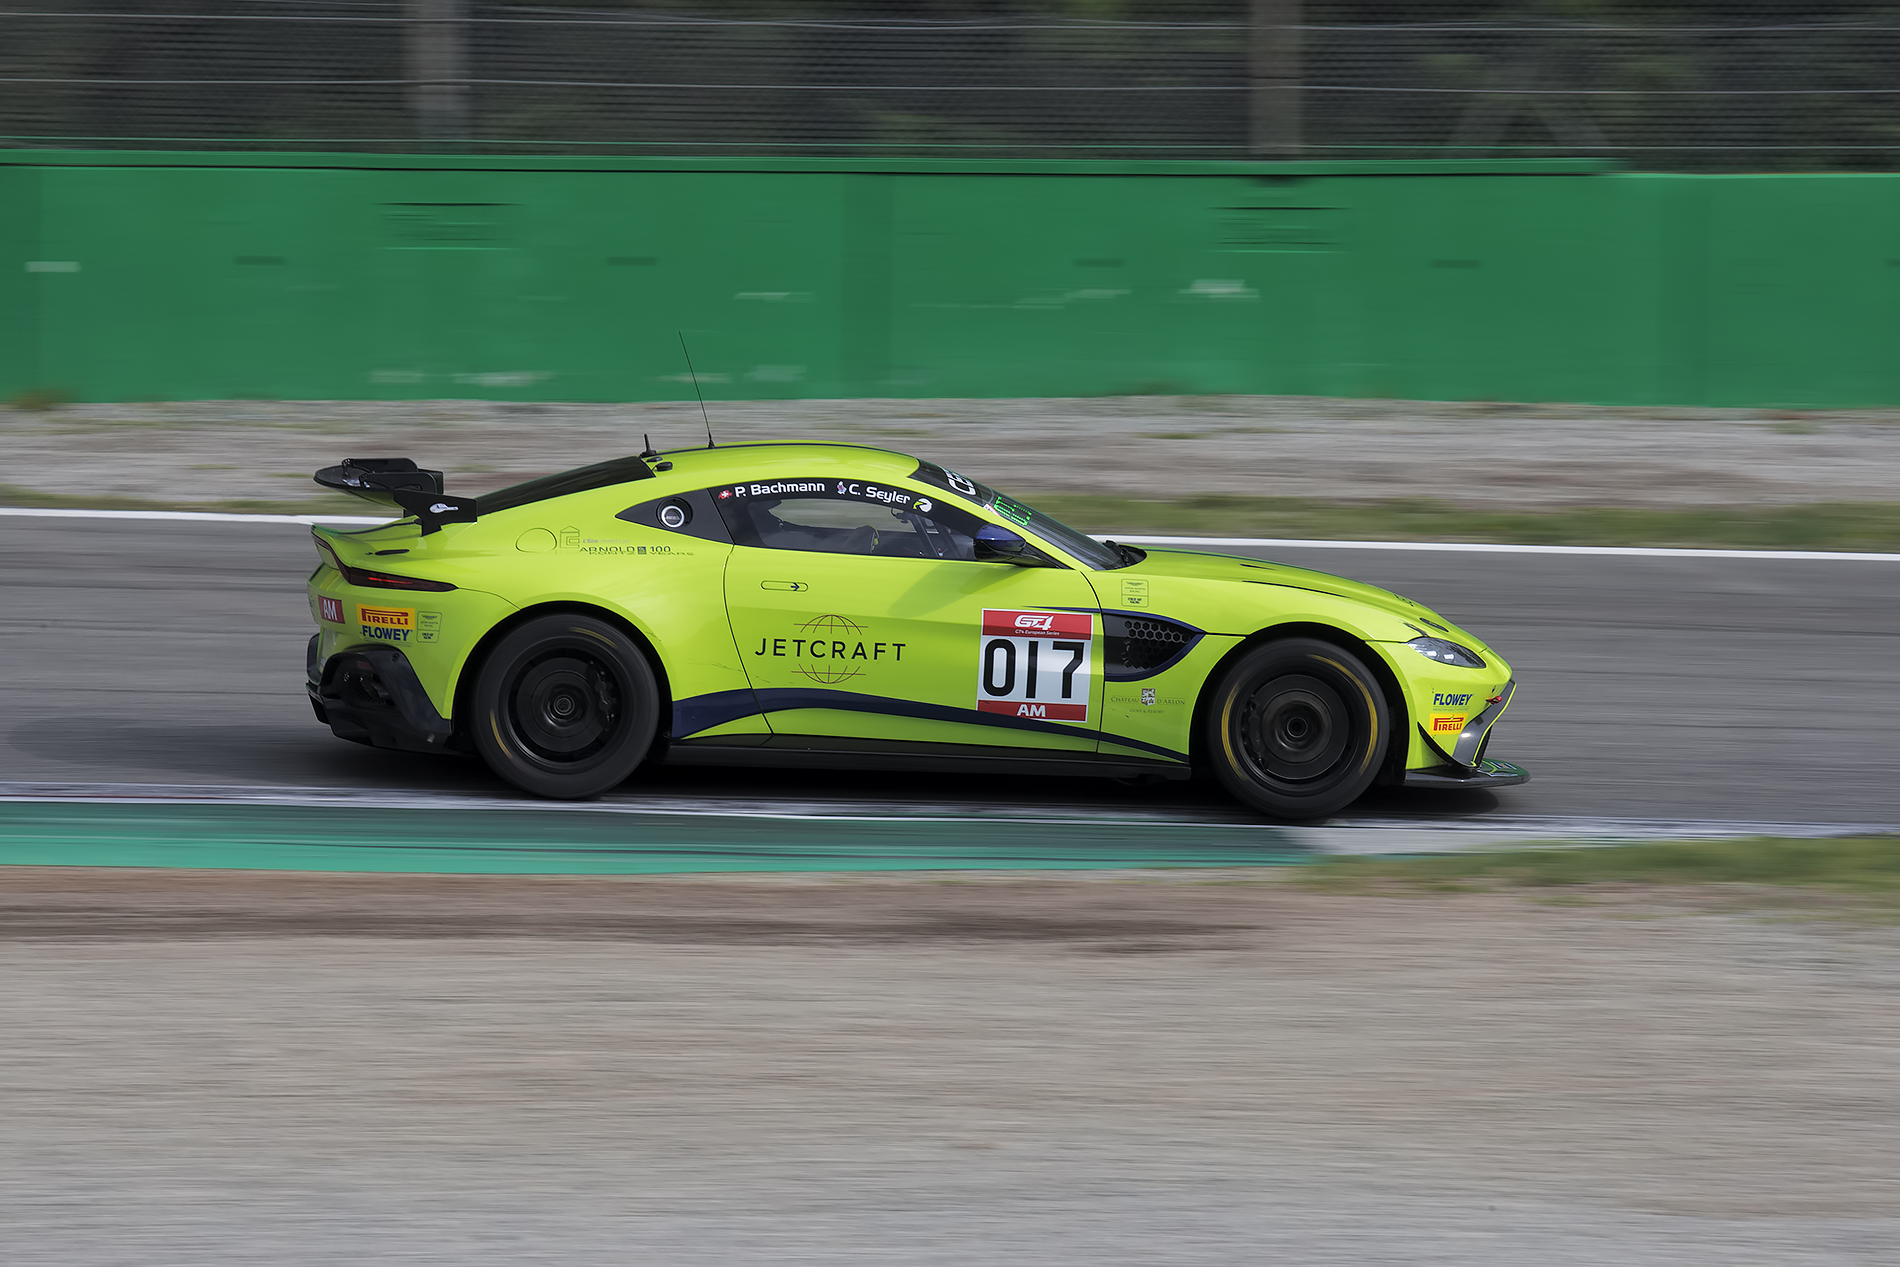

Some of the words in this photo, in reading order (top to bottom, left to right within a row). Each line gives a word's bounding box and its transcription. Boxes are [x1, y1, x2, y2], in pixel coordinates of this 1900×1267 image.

[734, 486, 747, 498] P.
[751, 482, 825, 496] Bachmann
[848, 484, 861, 496] C.
[865, 486, 911, 504] Seyler
[579, 545, 635, 553] ARNOLD
[649, 545, 671, 553] 100
[323, 599, 338, 621] AM
[361, 608, 409, 626] PIRELLI
[1014, 614, 1054, 630] GT4
[361, 625, 411, 641] FLOWEY
[754, 637, 906, 661] JETCRAFT
[983, 638, 1085, 699] 017
[1433, 693, 1473, 706] FLOWEY
[1016, 703, 1046, 718] AM
[1433, 717, 1464, 731] PIRELLI
